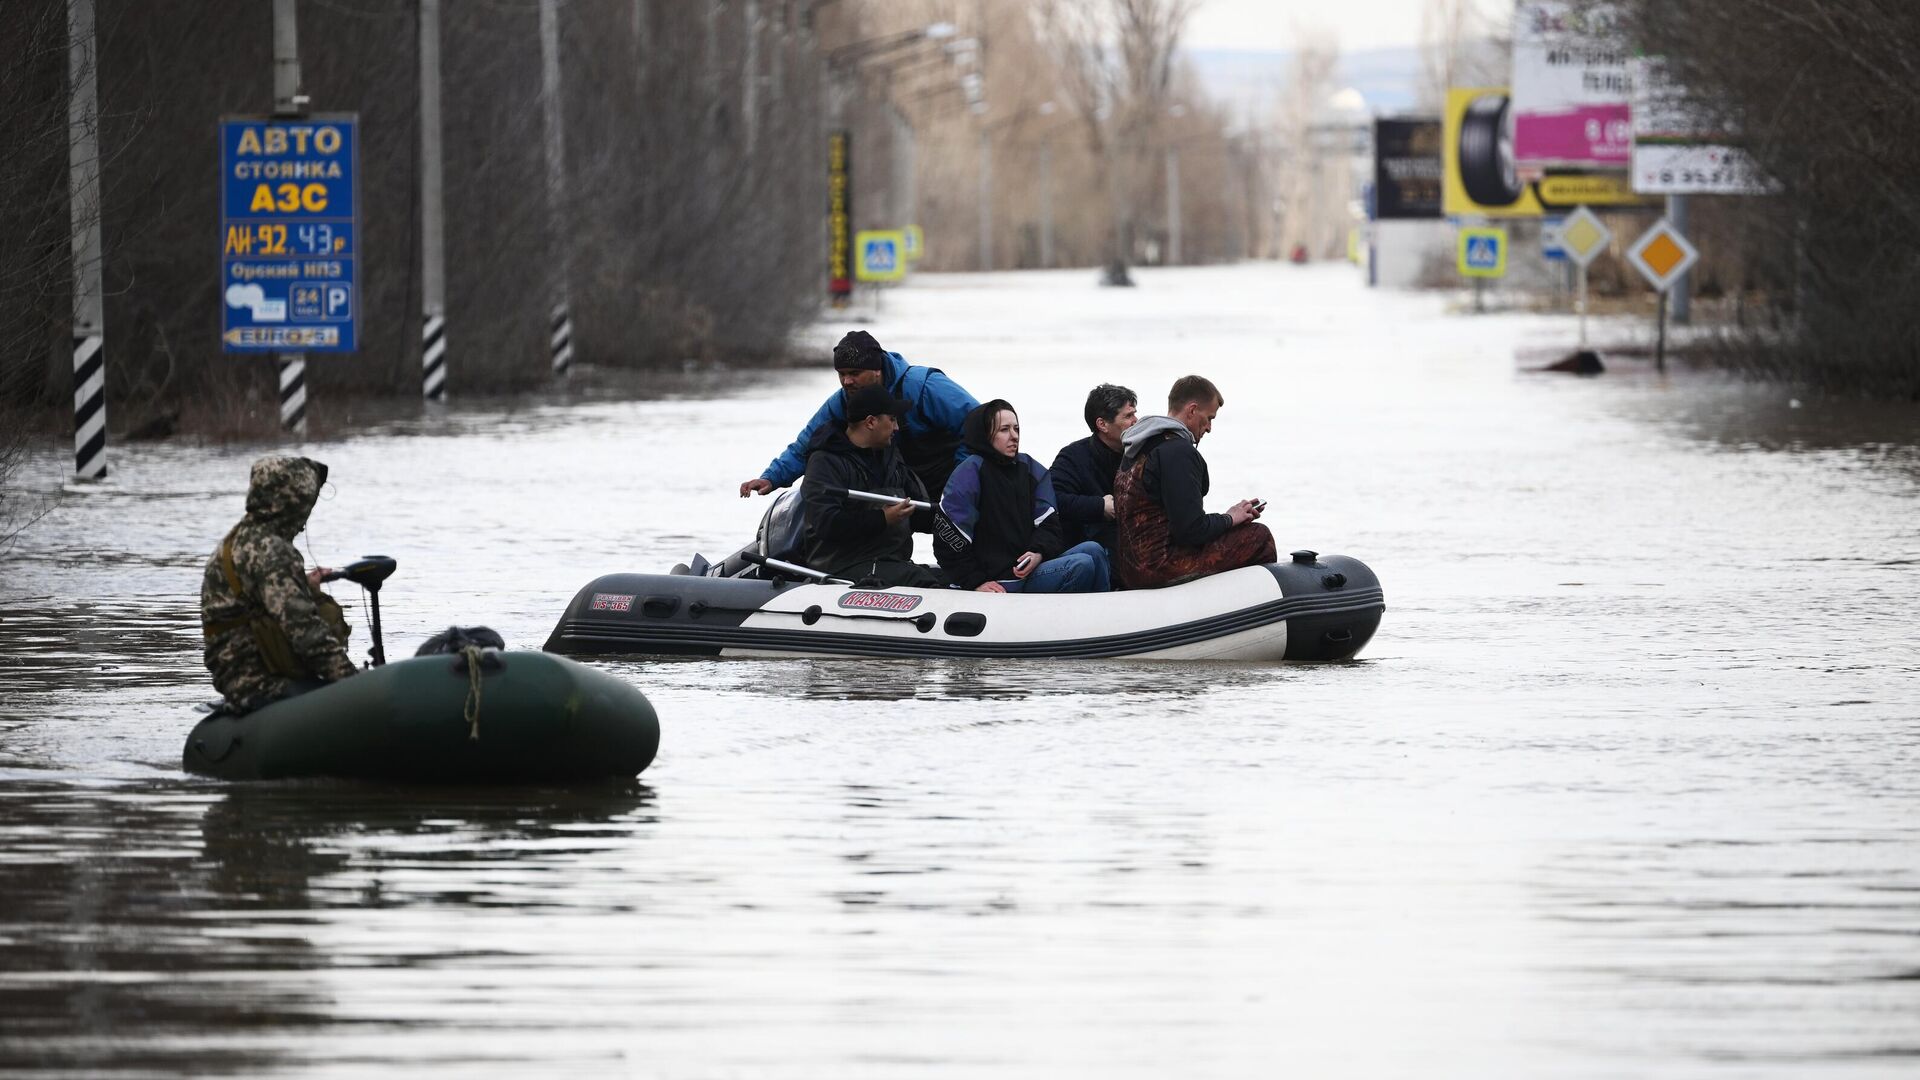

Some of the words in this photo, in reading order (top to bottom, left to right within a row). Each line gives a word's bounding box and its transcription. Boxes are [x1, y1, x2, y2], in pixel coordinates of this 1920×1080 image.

[237, 126, 341, 155] АВТО
[234, 160, 341, 179] СТОЯНКА
[250, 183, 328, 212] АЗС
[231, 261, 299, 281] Орский
[304, 261, 341, 278] НПЗ
[842, 591, 919, 611] KASATKA
